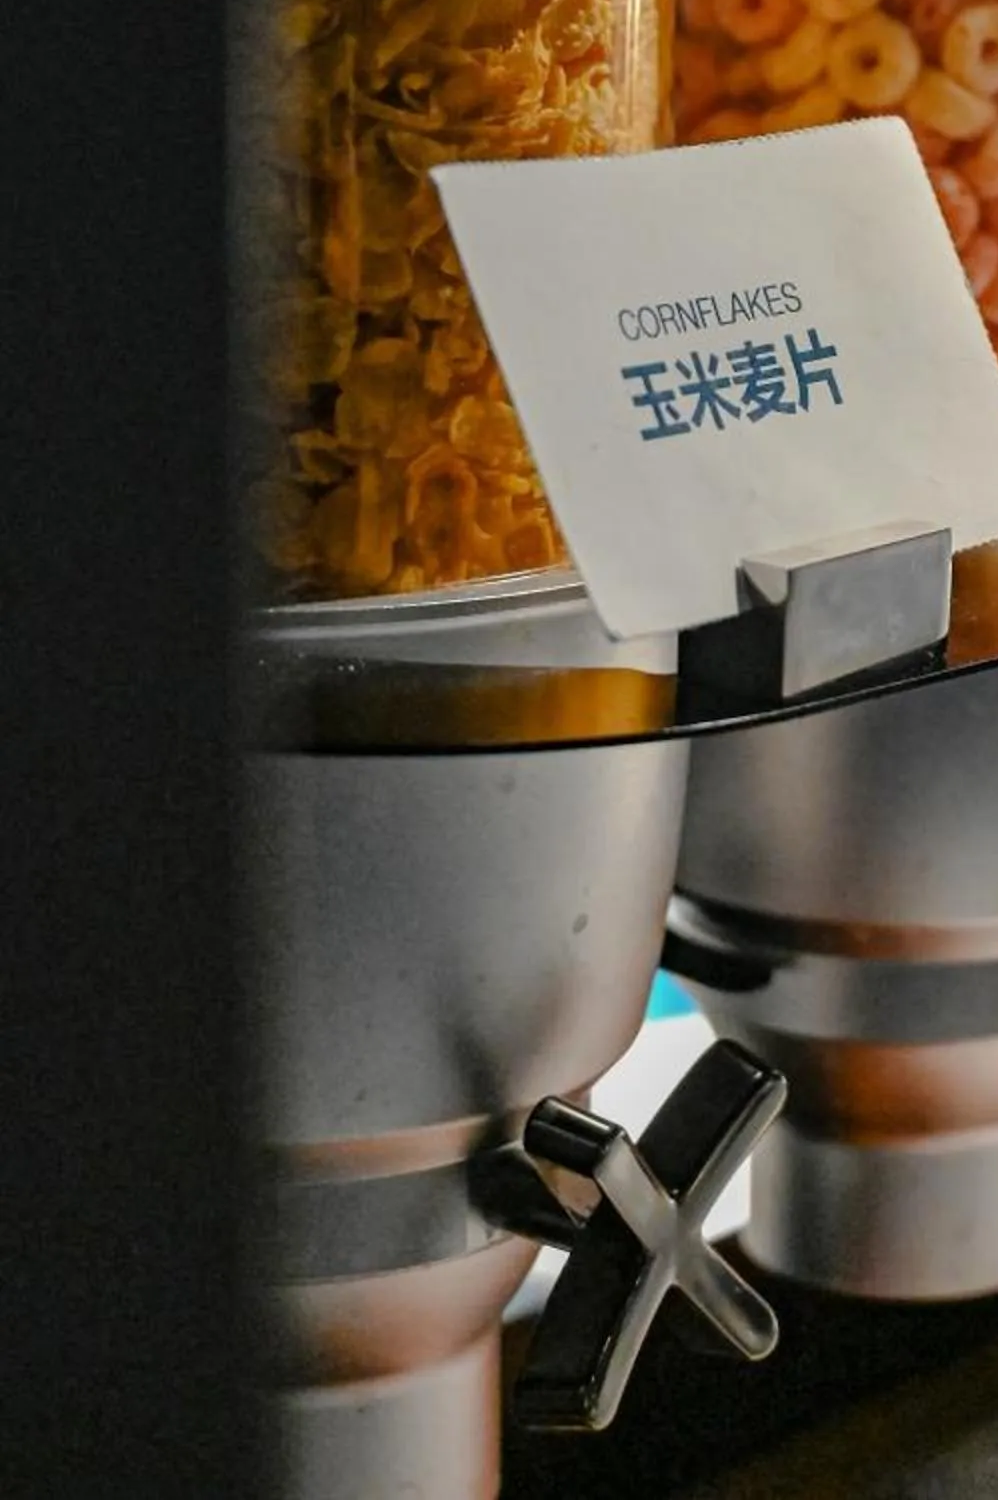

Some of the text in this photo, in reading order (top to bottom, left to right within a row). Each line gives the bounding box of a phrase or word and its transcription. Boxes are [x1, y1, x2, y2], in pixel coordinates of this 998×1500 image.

[618, 282, 803, 341] CORNFLAKES
[621, 328, 843, 441] 玉米麦片
